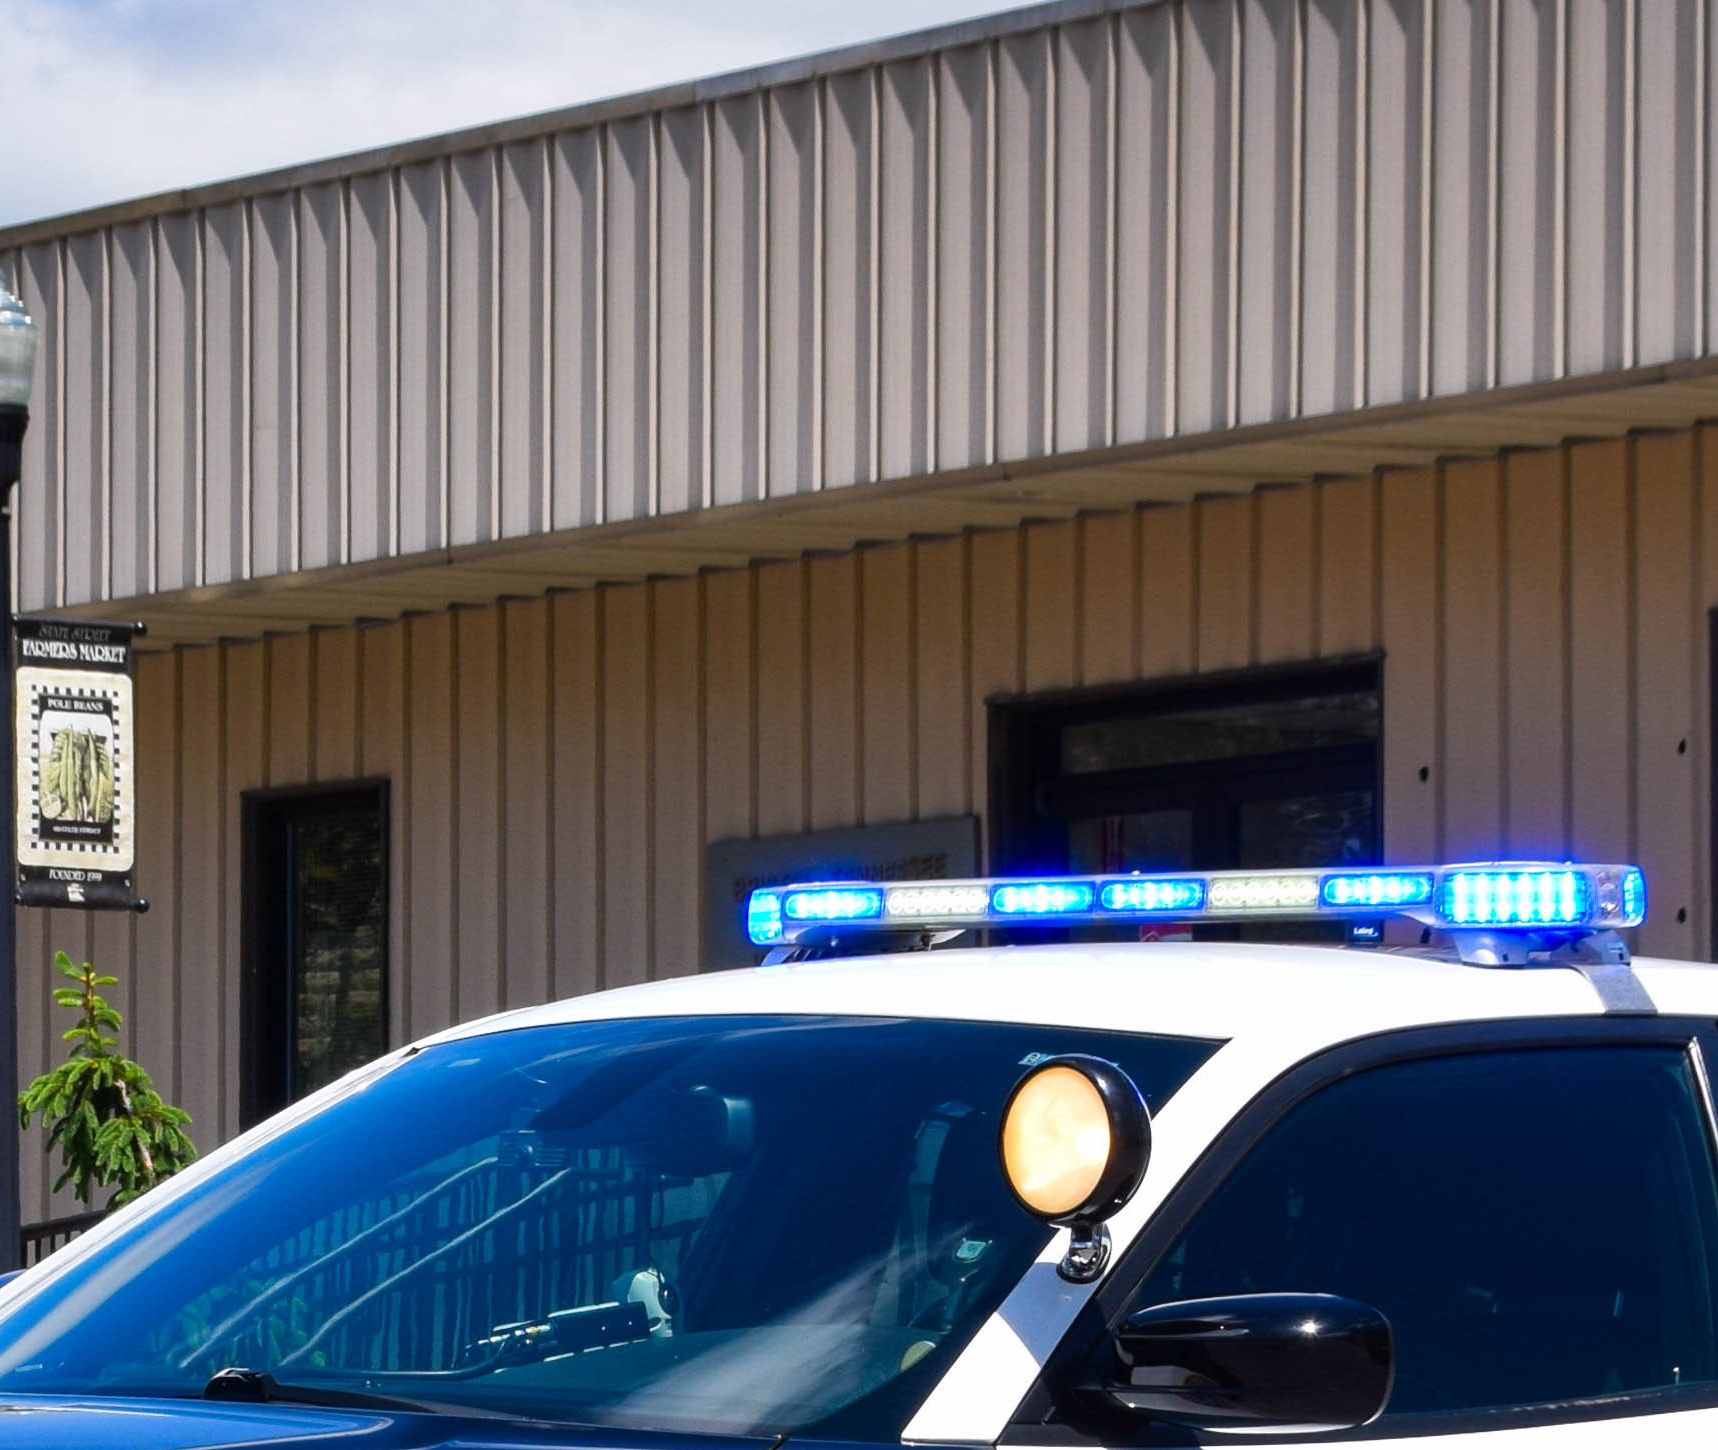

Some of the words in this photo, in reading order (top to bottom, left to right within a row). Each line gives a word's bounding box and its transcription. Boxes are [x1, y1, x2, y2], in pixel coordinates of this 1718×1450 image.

[22, 639, 78, 659] FARMERS
[79, 643, 126, 663] MARKET
[47, 698, 71, 709] POLE
[73, 700, 103, 711] BEANS
[49, 869, 85, 880] FOUNDED
